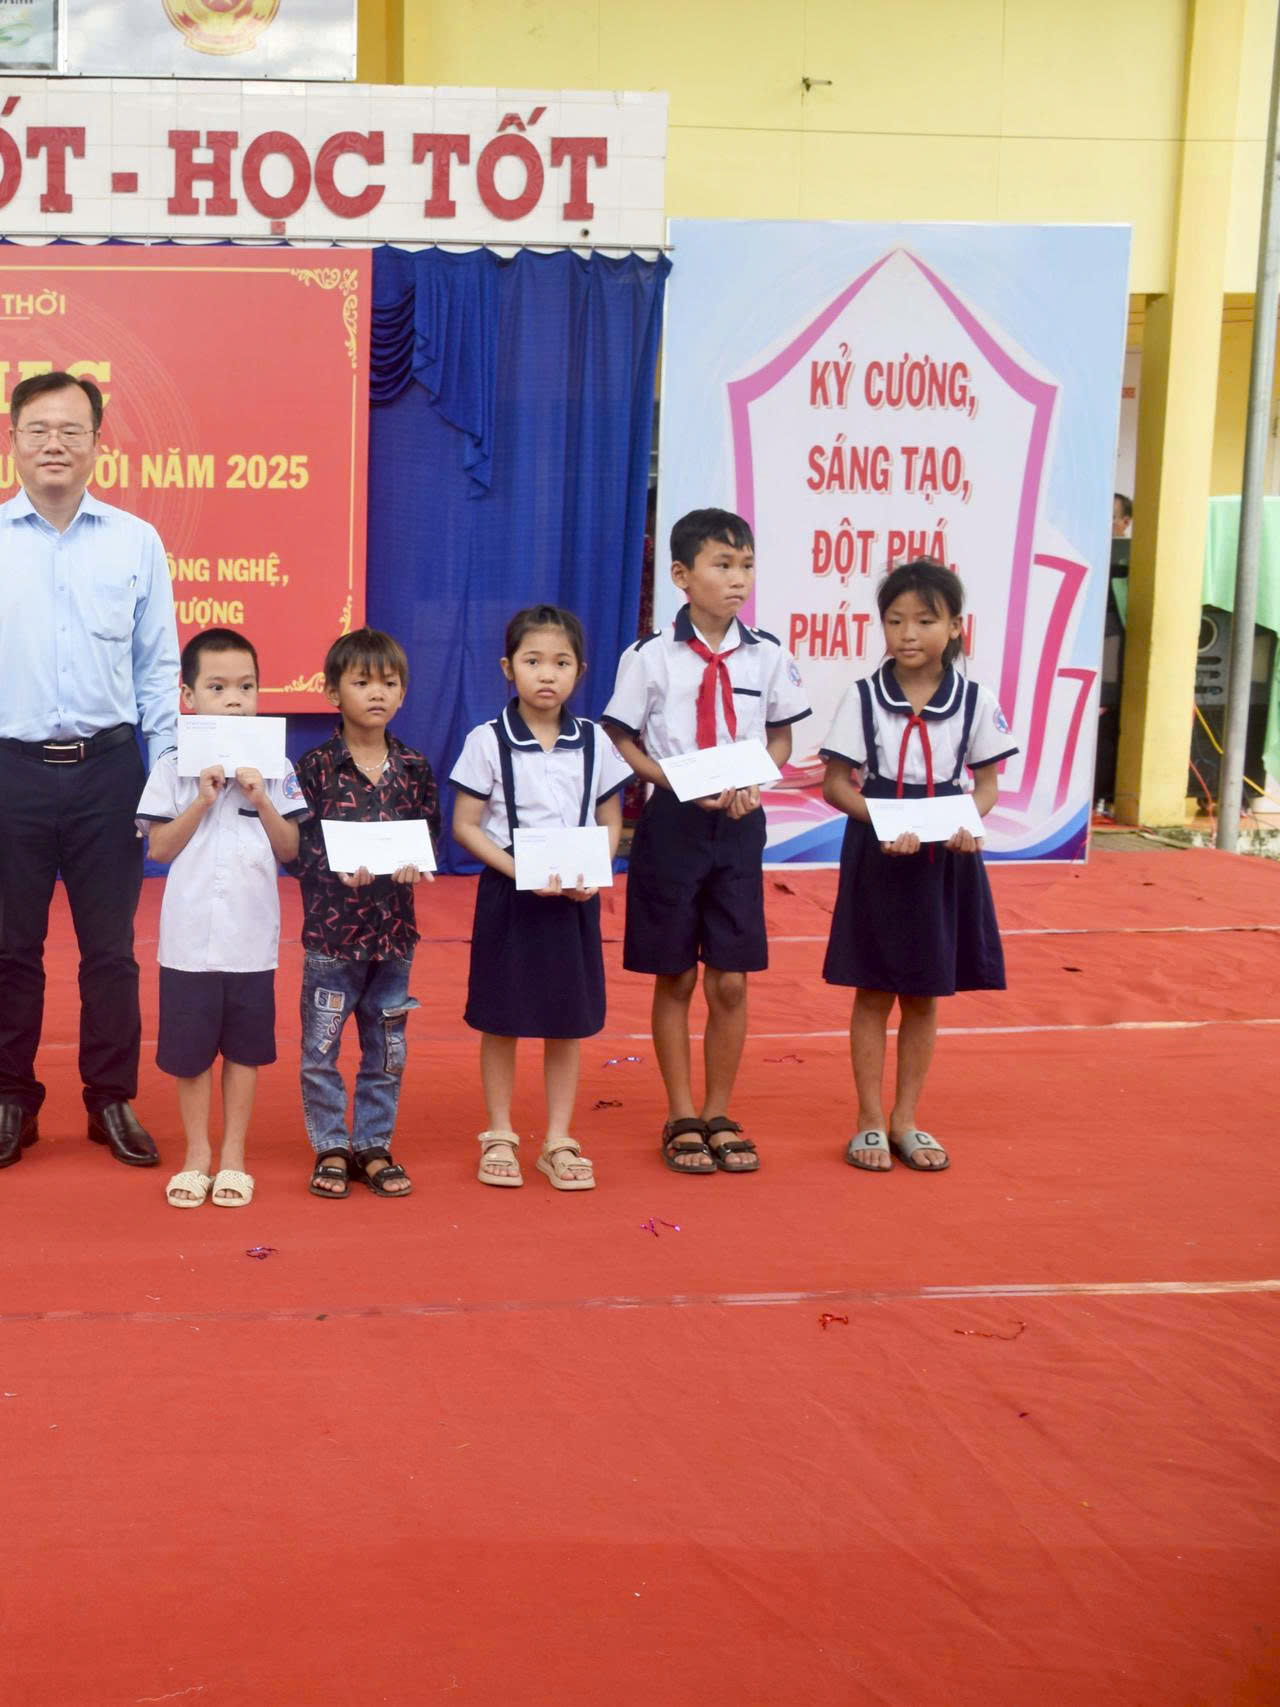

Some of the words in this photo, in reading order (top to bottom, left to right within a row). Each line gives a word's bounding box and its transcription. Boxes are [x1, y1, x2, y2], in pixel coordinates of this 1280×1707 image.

[112, 172, 138, 192] -
[167, 130, 386, 235] HỌC
[412, 107, 608, 221] TỐT
[2, 290, 66, 315] THỜI
[809, 343, 850, 406] KỶ
[864, 354, 975, 413] CƯƠNG,
[85, 444, 129, 489] ỜI
[142, 449, 214, 488] NĂM
[227, 456, 308, 488] 2025
[806, 433, 890, 491] SÁNG
[901, 446, 970, 500] TẠO,
[166, 552, 210, 582] ÔNG
[217, 552, 289, 587] NGHỆ,
[812, 517, 875, 583] ĐỘT
[789, 601, 870, 656] PHÁT
[865, 1131, 879, 1146] C
[915, 1133, 931, 1145] C
